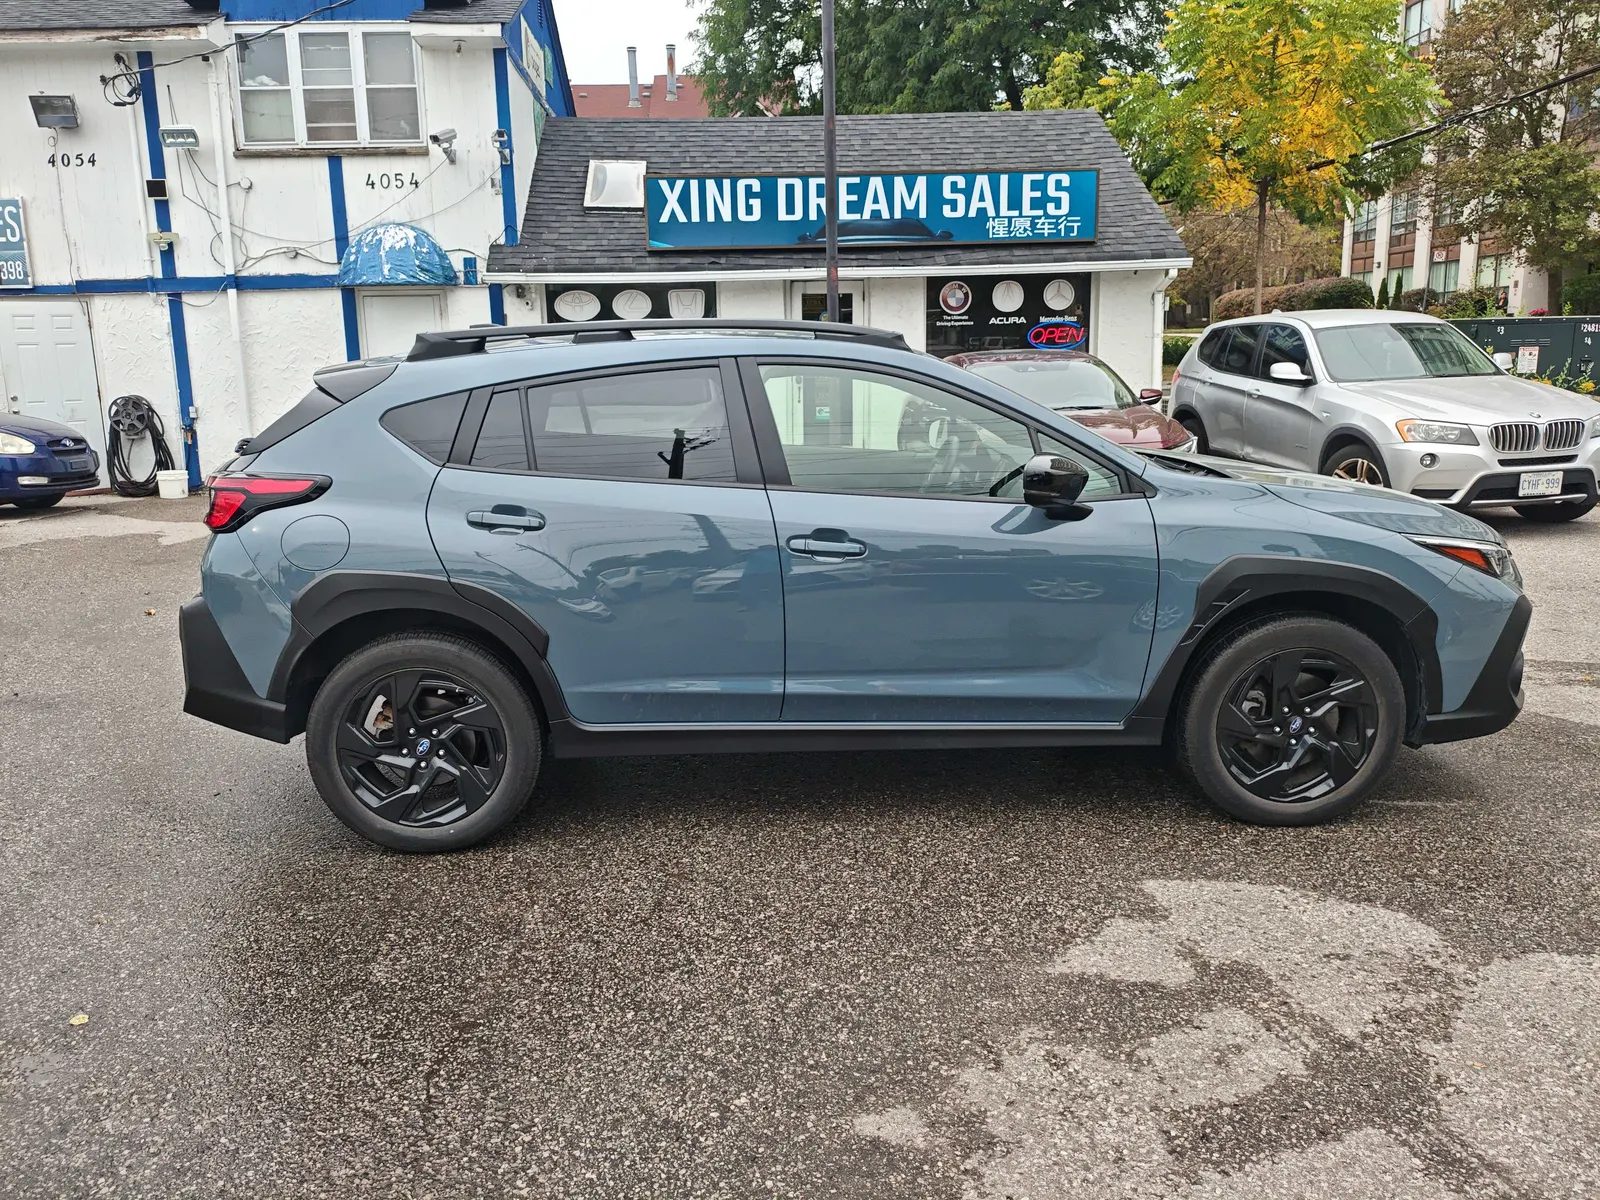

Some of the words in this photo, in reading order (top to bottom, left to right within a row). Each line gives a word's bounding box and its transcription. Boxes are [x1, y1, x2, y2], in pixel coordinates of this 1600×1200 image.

[47, 152, 97, 168] 4054
[365, 172, 420, 190] 4054
[658, 178, 762, 223] XING
[777, 175, 927, 221] DREAM
[942, 173, 1070, 218] SALES
[986, 216, 1082, 238] 惺愿车行
[988, 316, 1027, 325] ACURA
[1039, 315, 1078, 323] Mercedes-Benz
[1029, 327, 1085, 343] OPEN
[1545, 477, 1560, 489] 999
